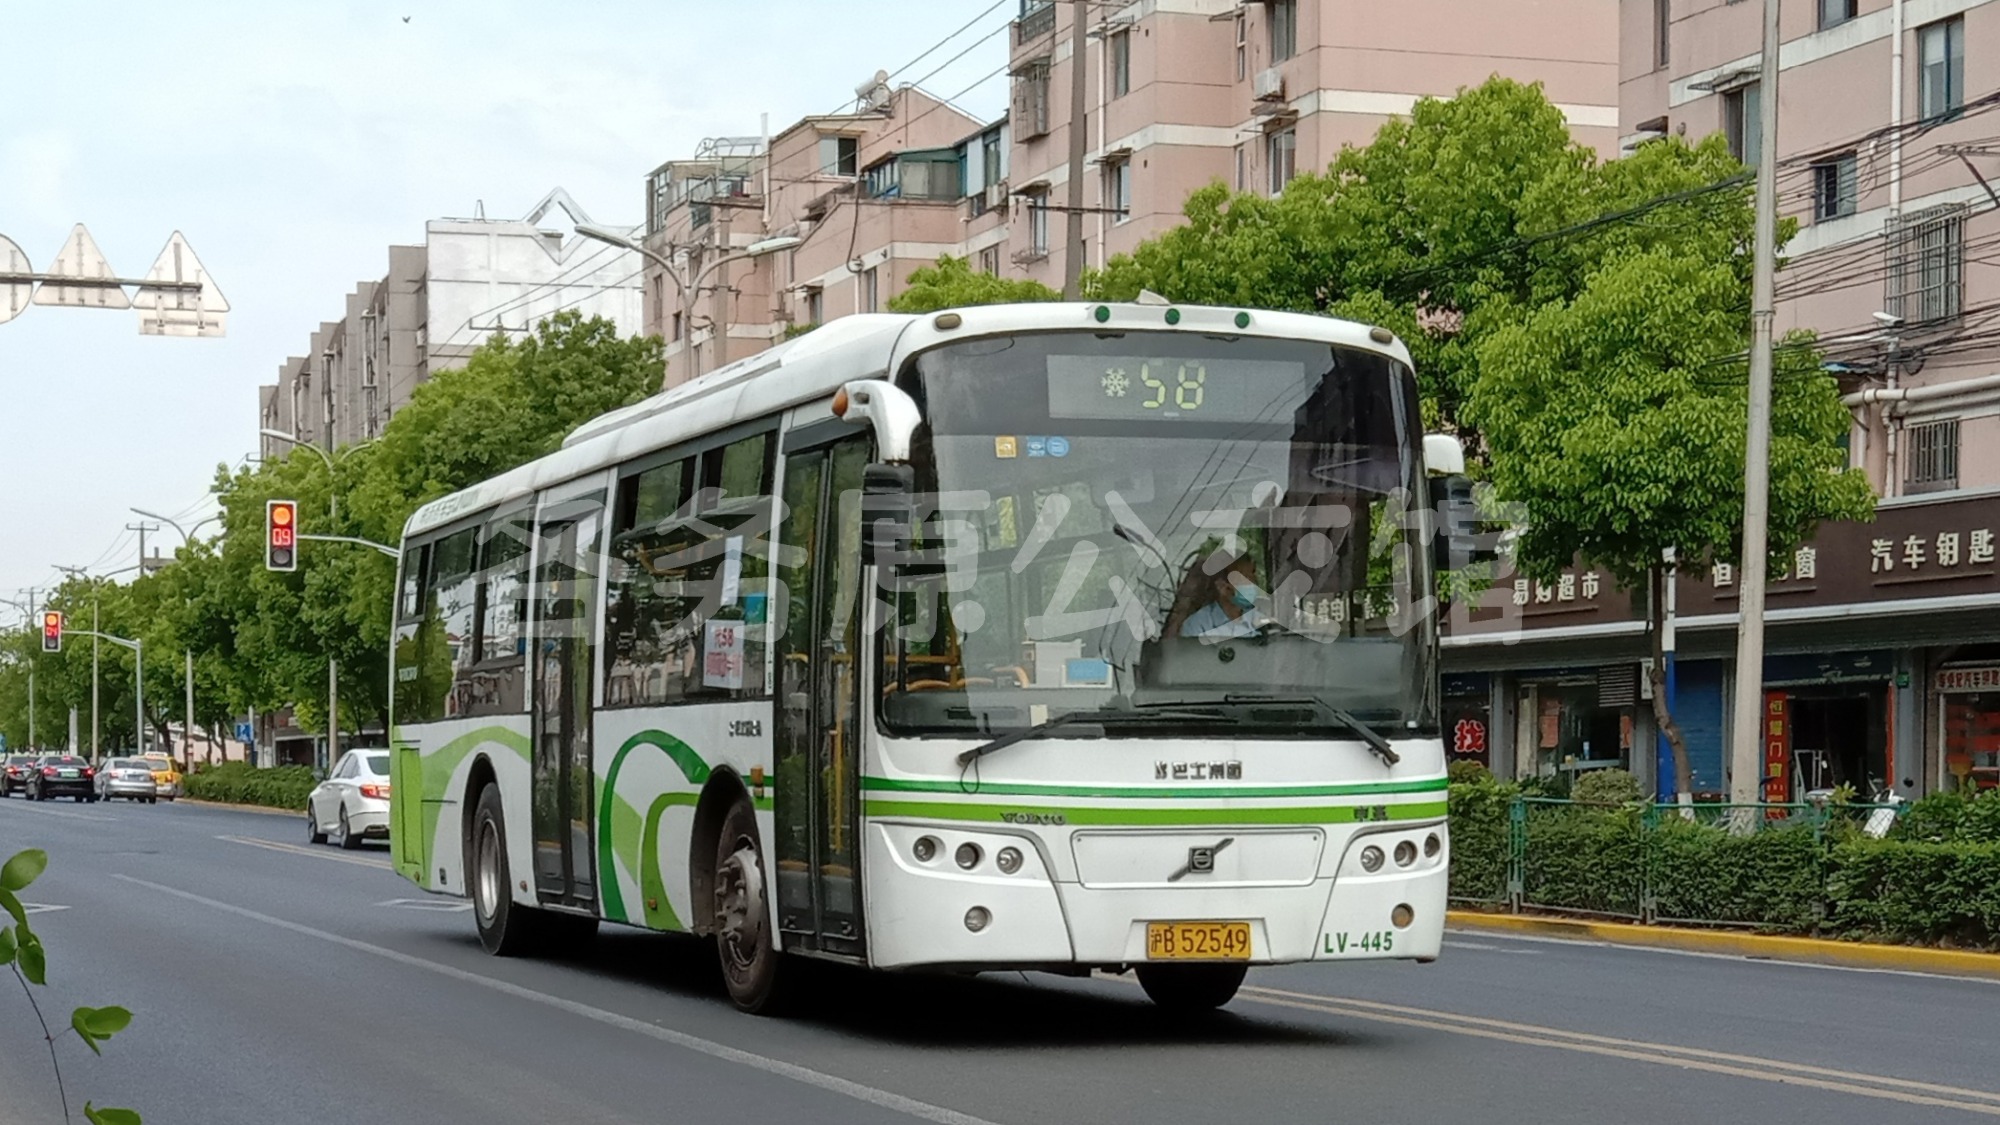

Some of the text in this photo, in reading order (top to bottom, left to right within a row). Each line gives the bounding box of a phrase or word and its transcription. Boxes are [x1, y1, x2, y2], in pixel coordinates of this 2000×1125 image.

[1141, 363, 1206, 409] 58
[272, 527, 291, 546] 09
[1870, 528, 1995, 573] 汽车钥匙
[1324, 930, 1393, 954] LV-445
